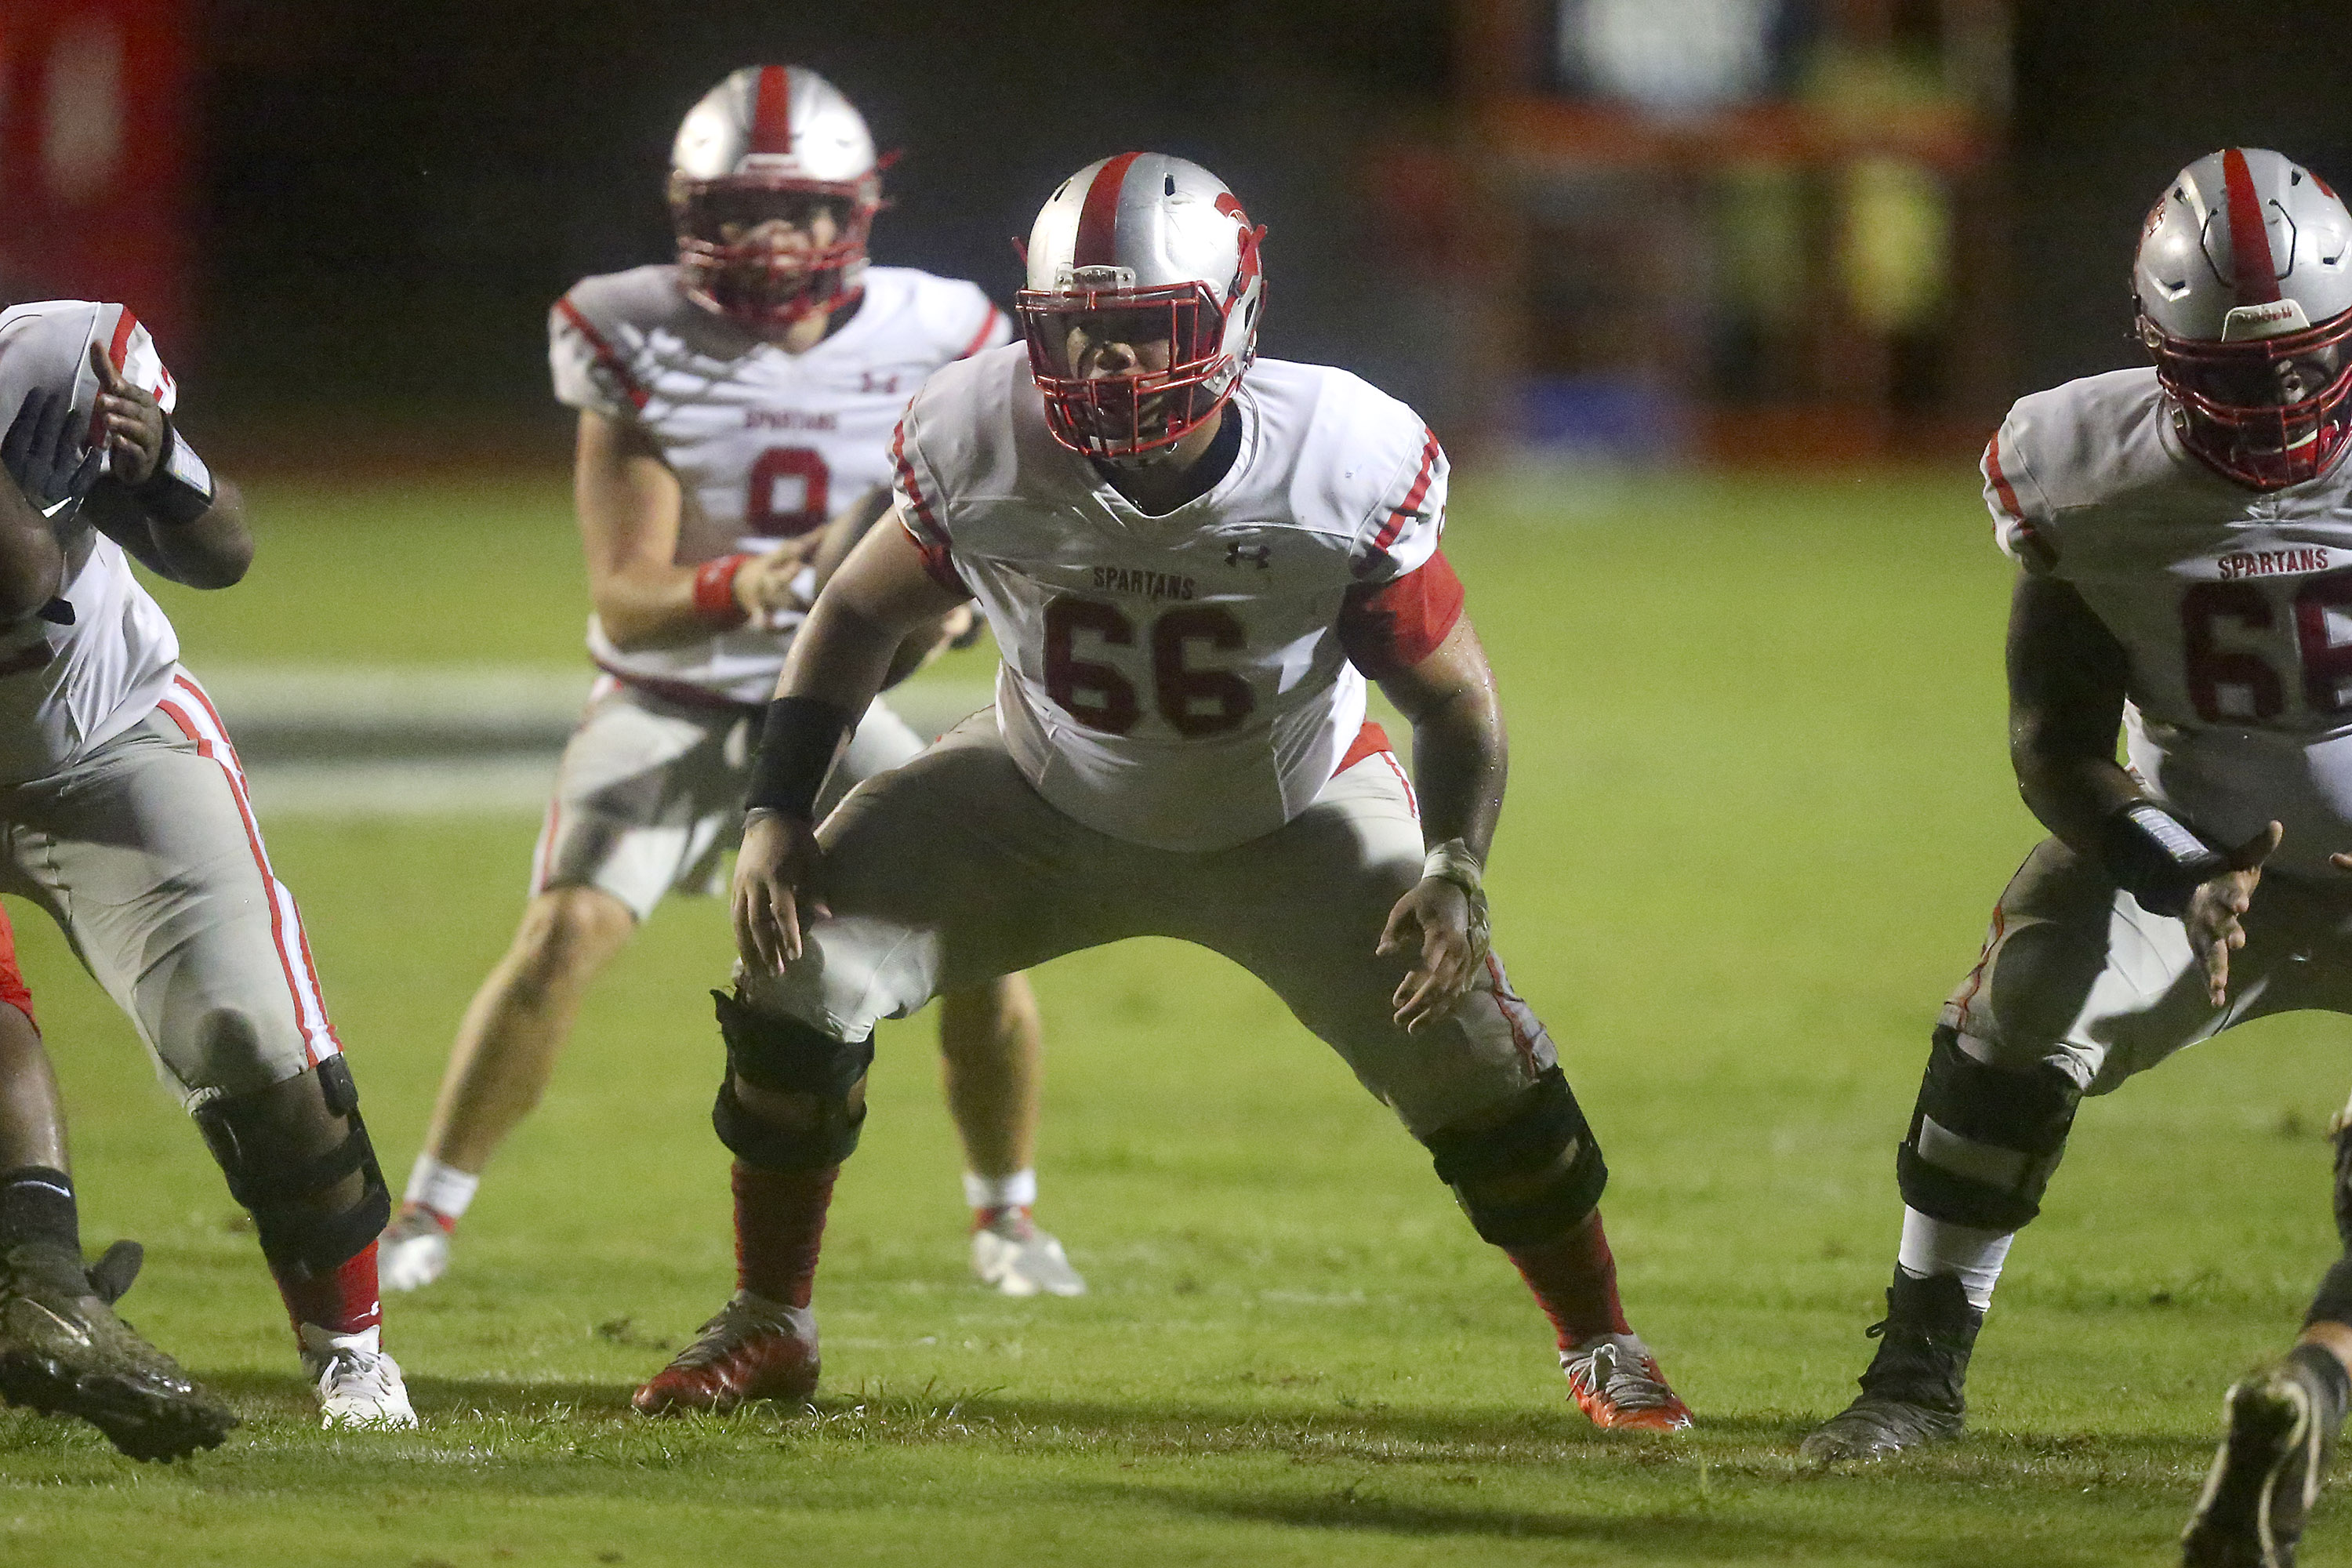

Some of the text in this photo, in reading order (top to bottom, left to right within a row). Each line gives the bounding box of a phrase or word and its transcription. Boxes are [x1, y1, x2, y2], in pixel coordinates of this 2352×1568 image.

[2218, 548, 2328, 580] SPARTANS
[1093, 565, 1196, 601] SPARTANS
[1043, 590, 1255, 738] 66
